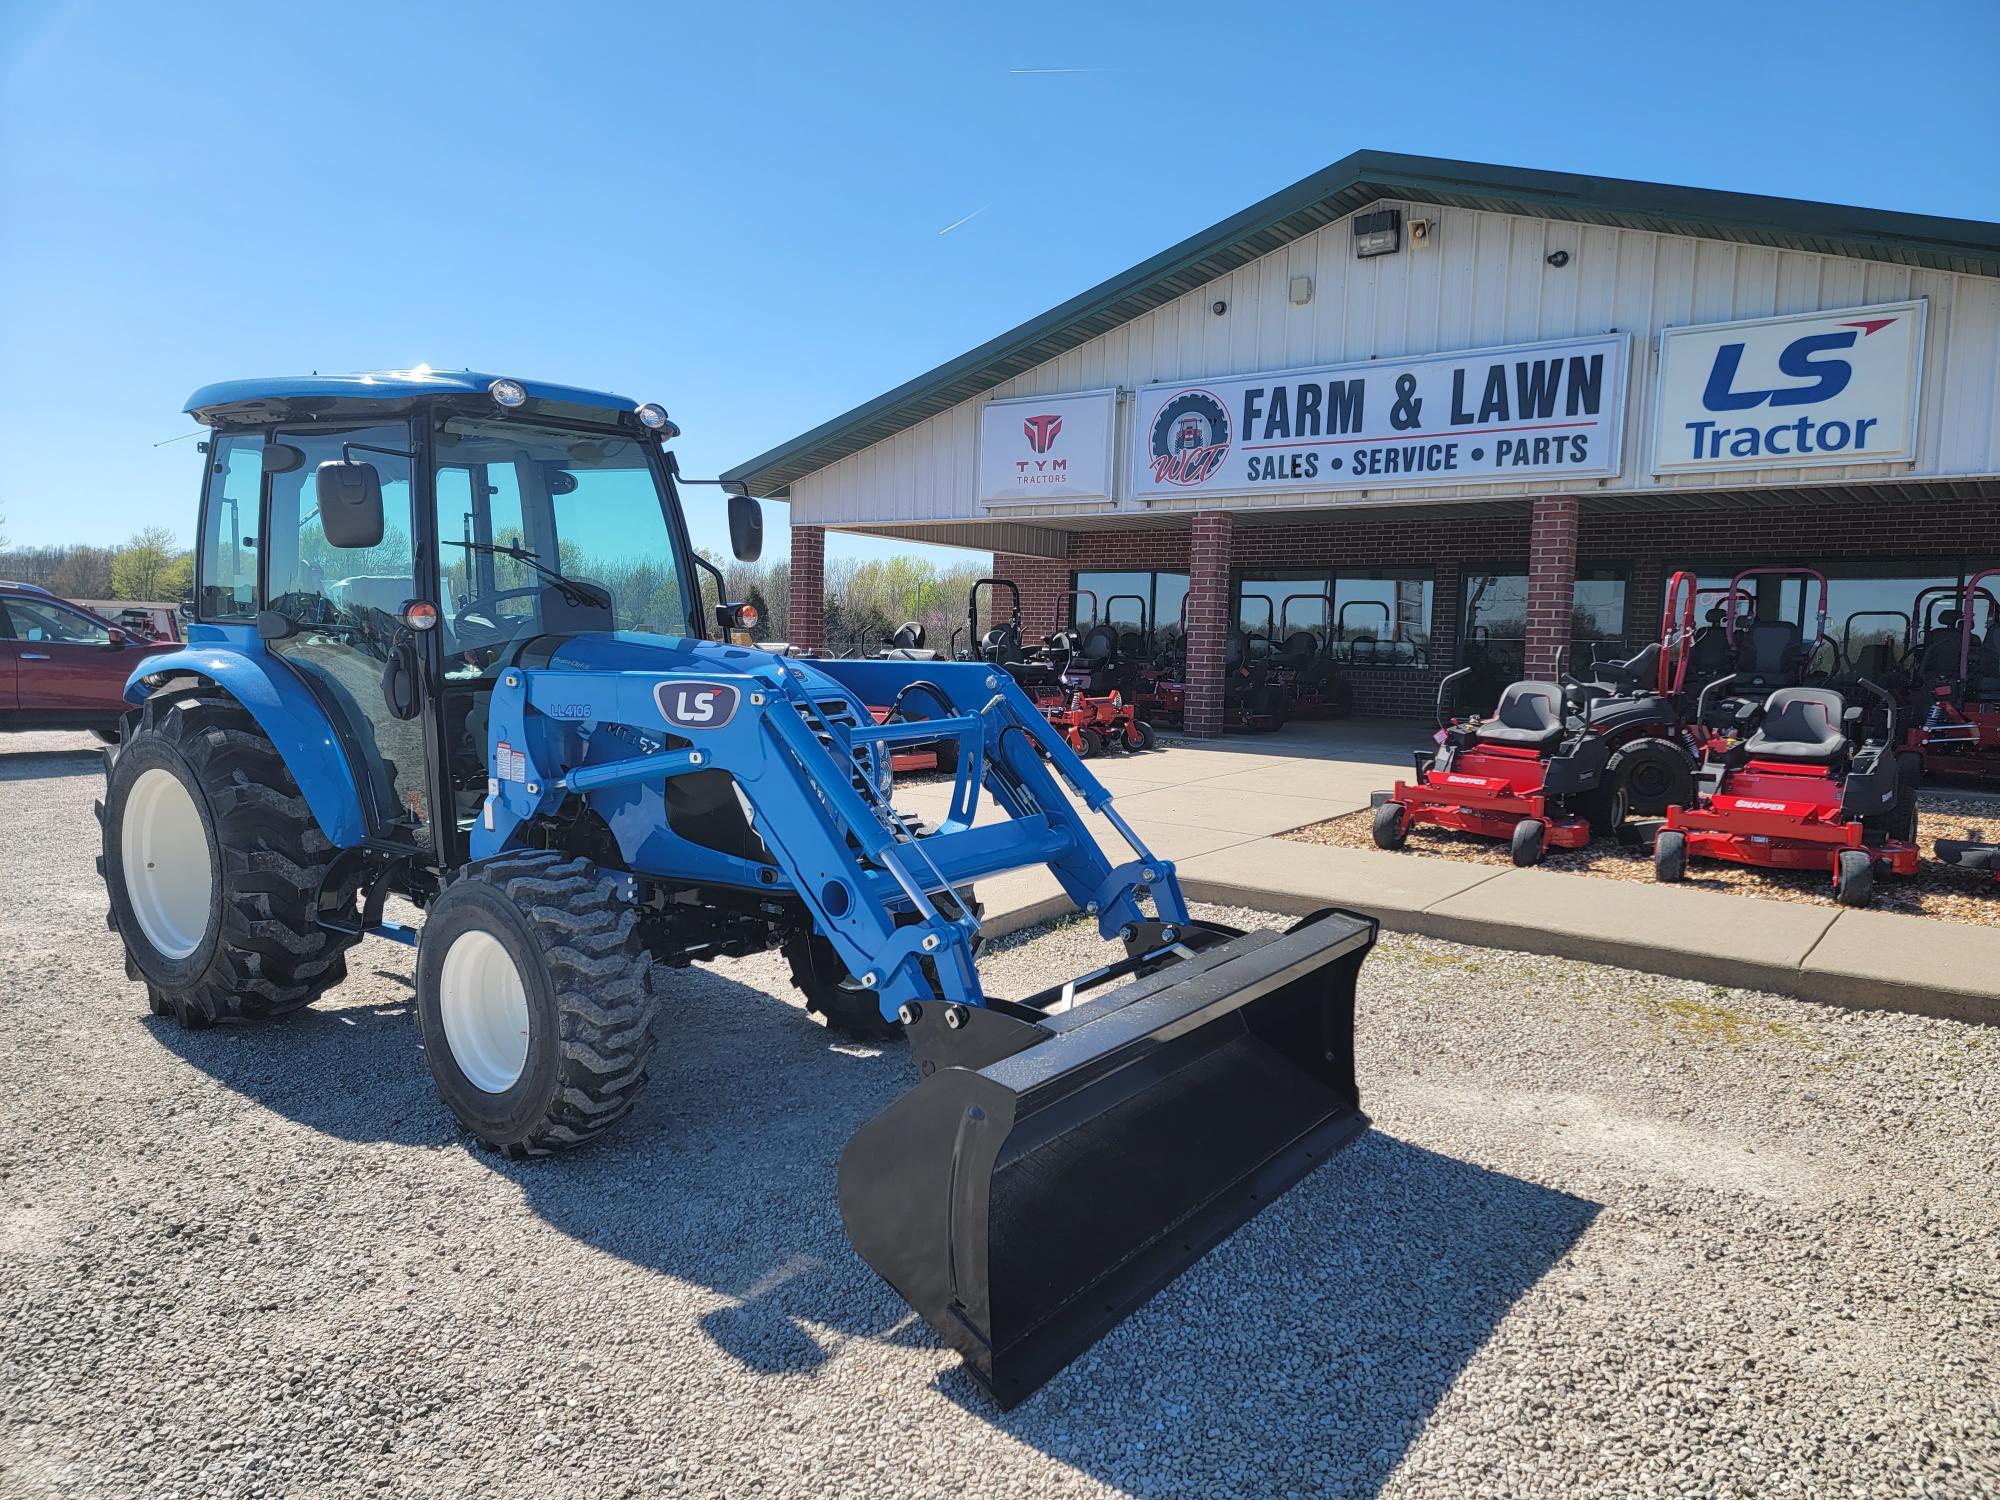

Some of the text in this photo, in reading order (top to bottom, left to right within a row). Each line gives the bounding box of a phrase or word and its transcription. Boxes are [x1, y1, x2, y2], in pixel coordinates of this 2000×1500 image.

[1702, 330, 1858, 412] LS
[1242, 354, 1604, 441] FARM & LAWN
[1685, 415, 1878, 460] Tractor
[1016, 459, 1067, 473] TYM
[1247, 434, 1588, 481] SALES SERVICE PARTS
[1016, 474, 1067, 485] TRACTORS
[676, 691, 715, 722] LS
[1446, 775, 1487, 786] SNAPPER
[1734, 799, 1786, 811] SNAPPER
